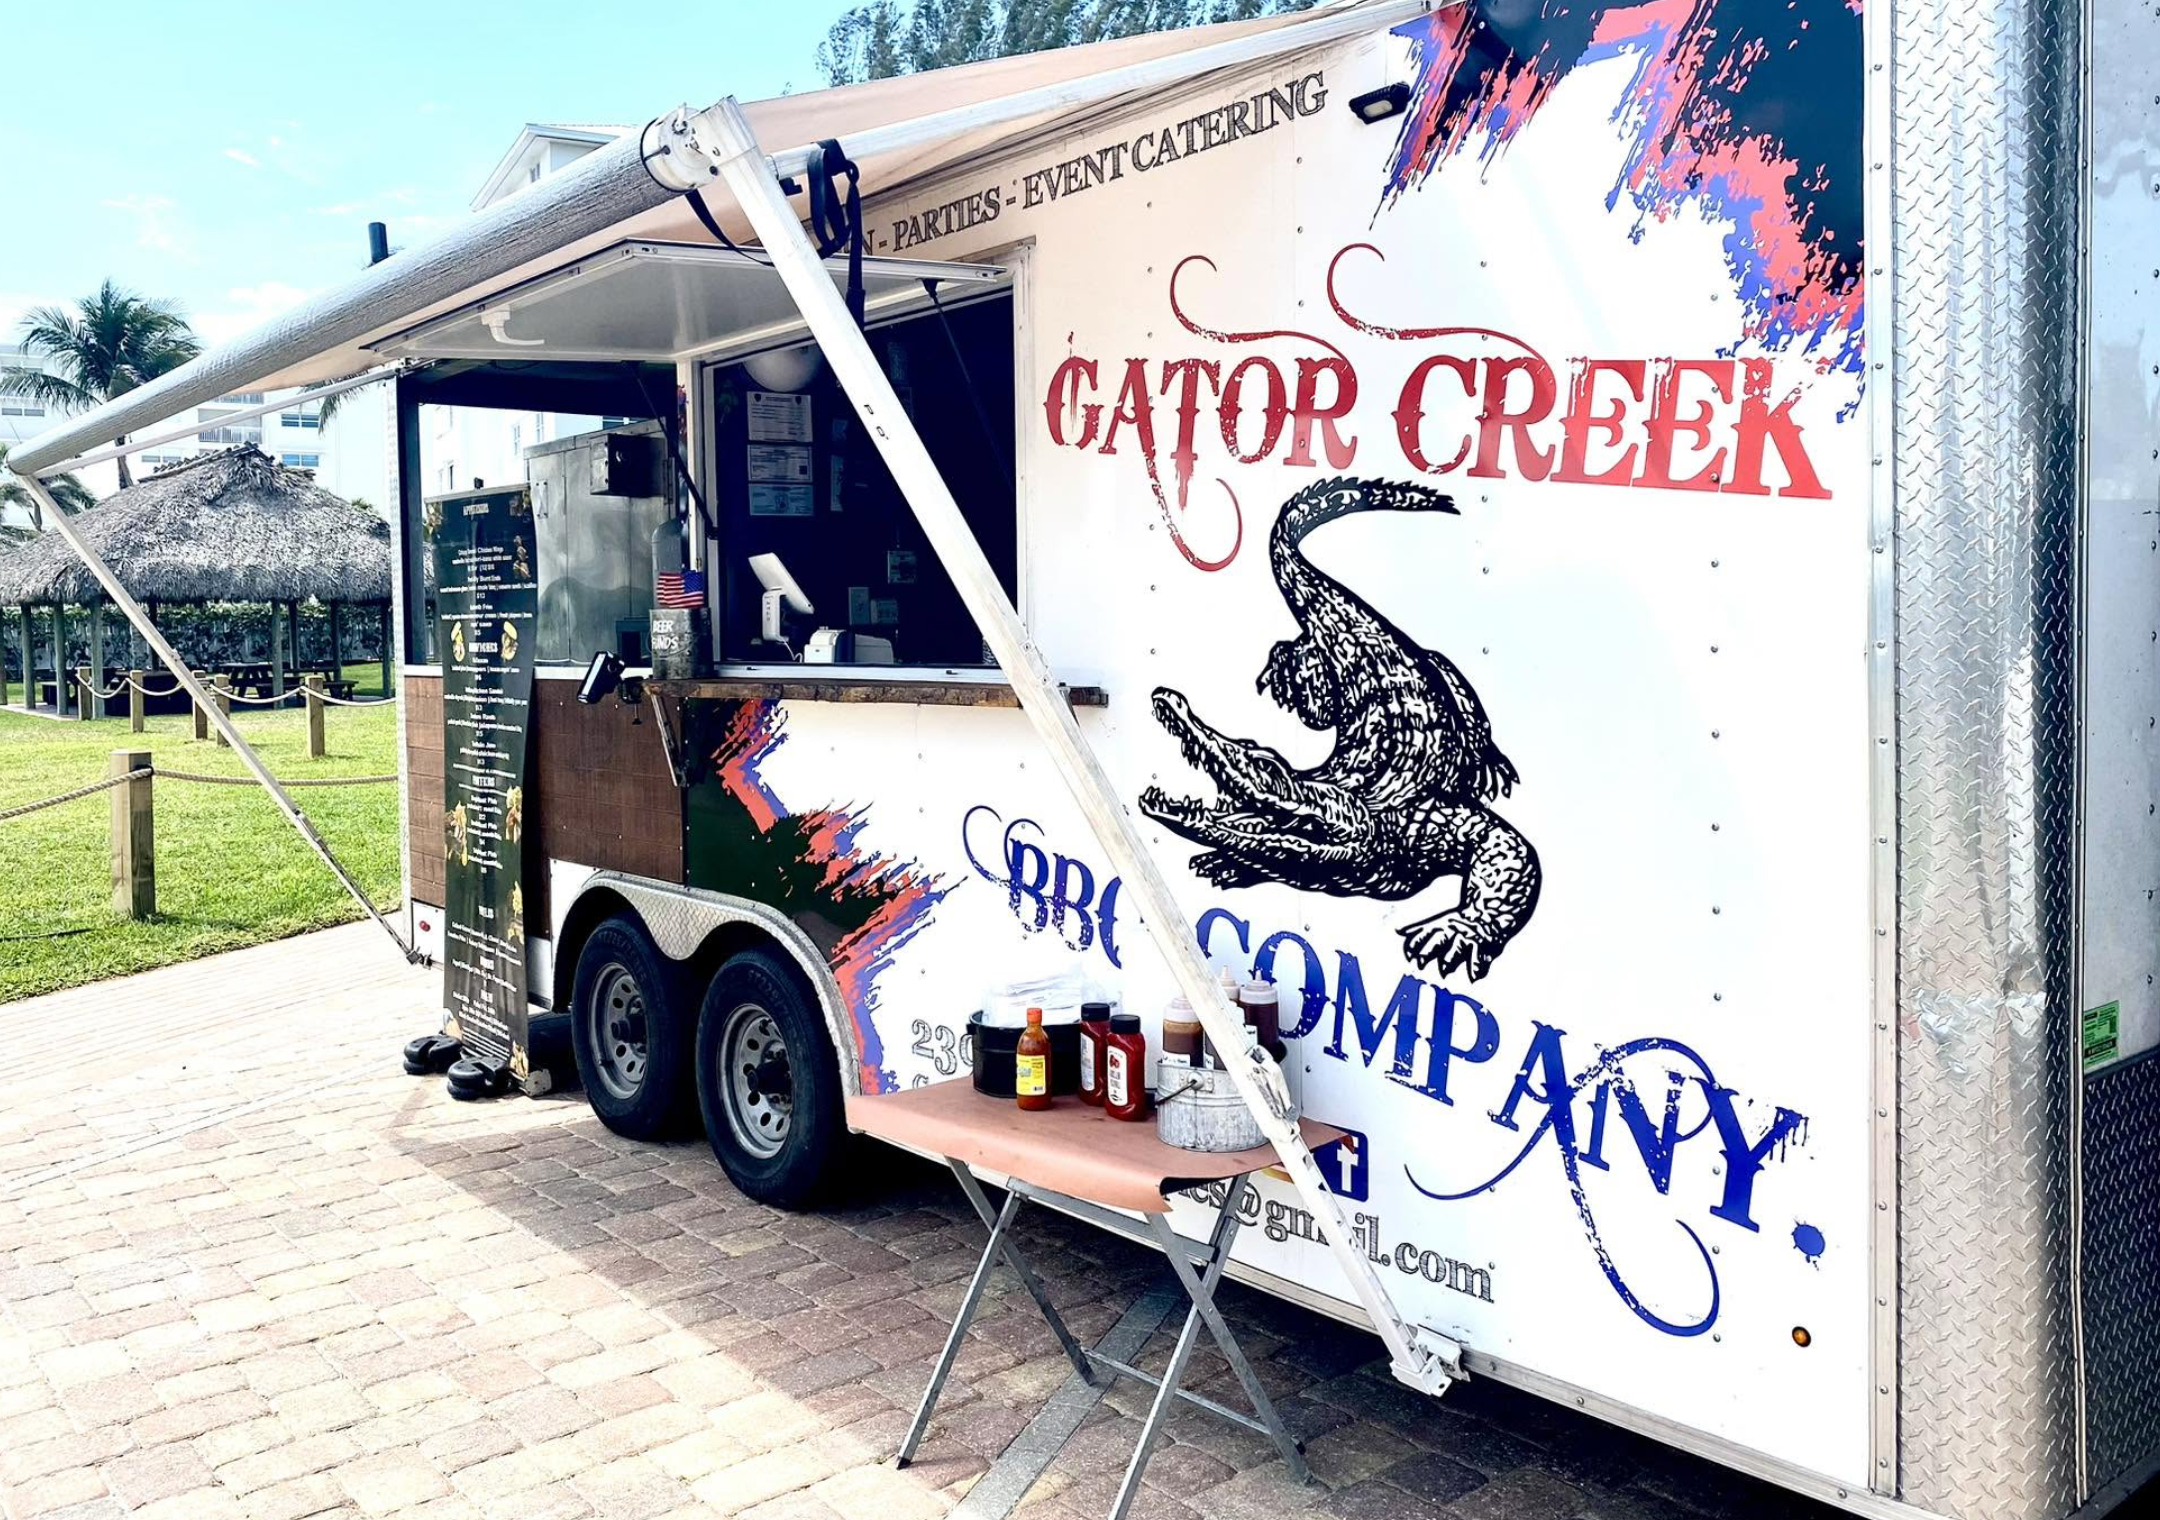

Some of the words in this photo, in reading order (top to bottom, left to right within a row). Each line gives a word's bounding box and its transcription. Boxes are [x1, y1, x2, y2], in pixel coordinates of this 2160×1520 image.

[893, 186, 1001, 252] PARTIES
[1023, 140, 1129, 210] EVENT
[1131, 70, 1328, 173] CATERING
[1386, 342, 1834, 500] CREEK
